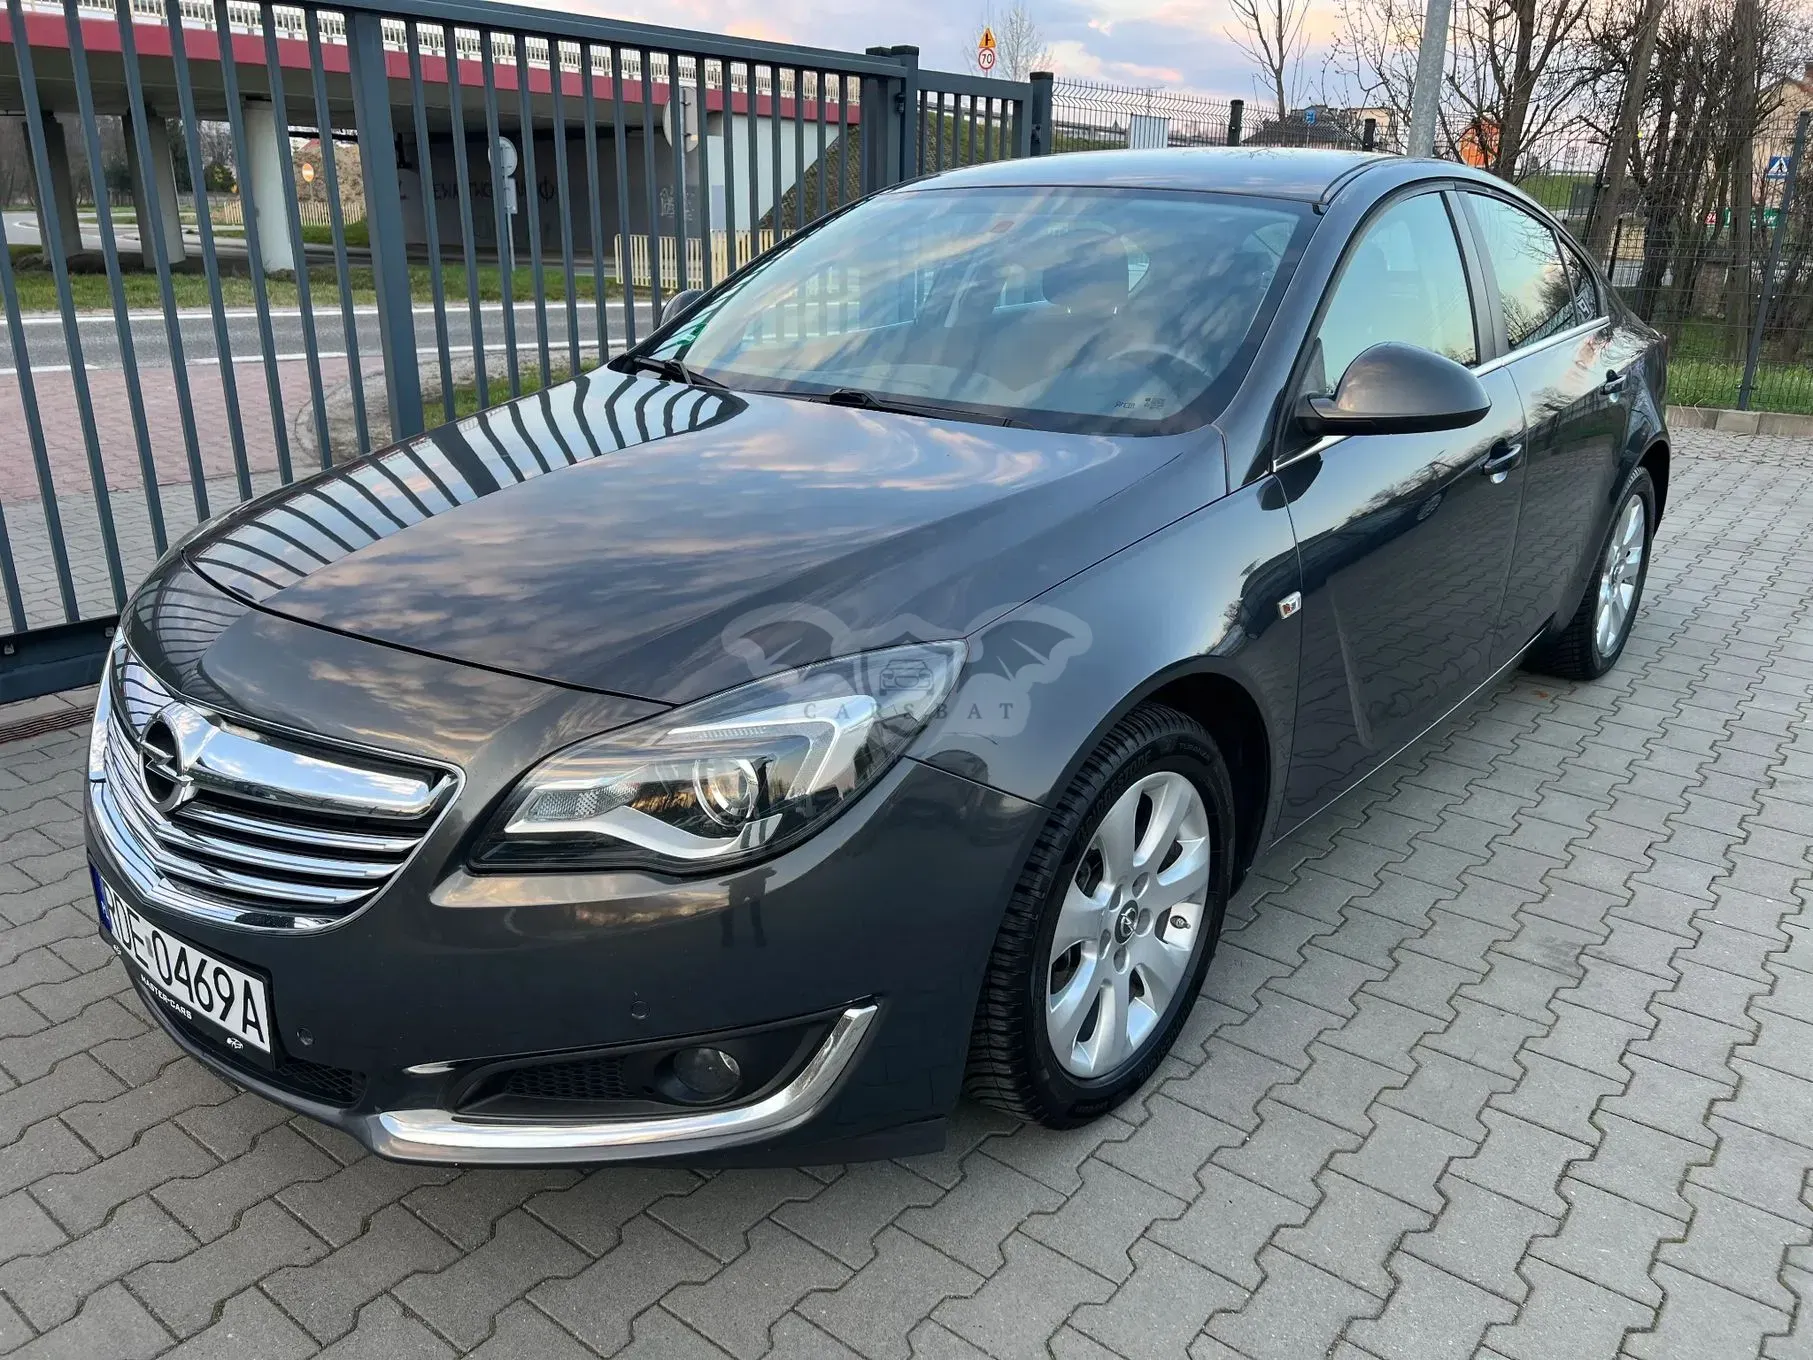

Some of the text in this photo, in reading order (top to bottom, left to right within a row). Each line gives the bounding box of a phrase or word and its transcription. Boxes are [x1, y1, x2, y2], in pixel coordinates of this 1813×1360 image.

[982, 53, 993, 64] 70
[103, 881, 266, 1044] RDE 0469A
